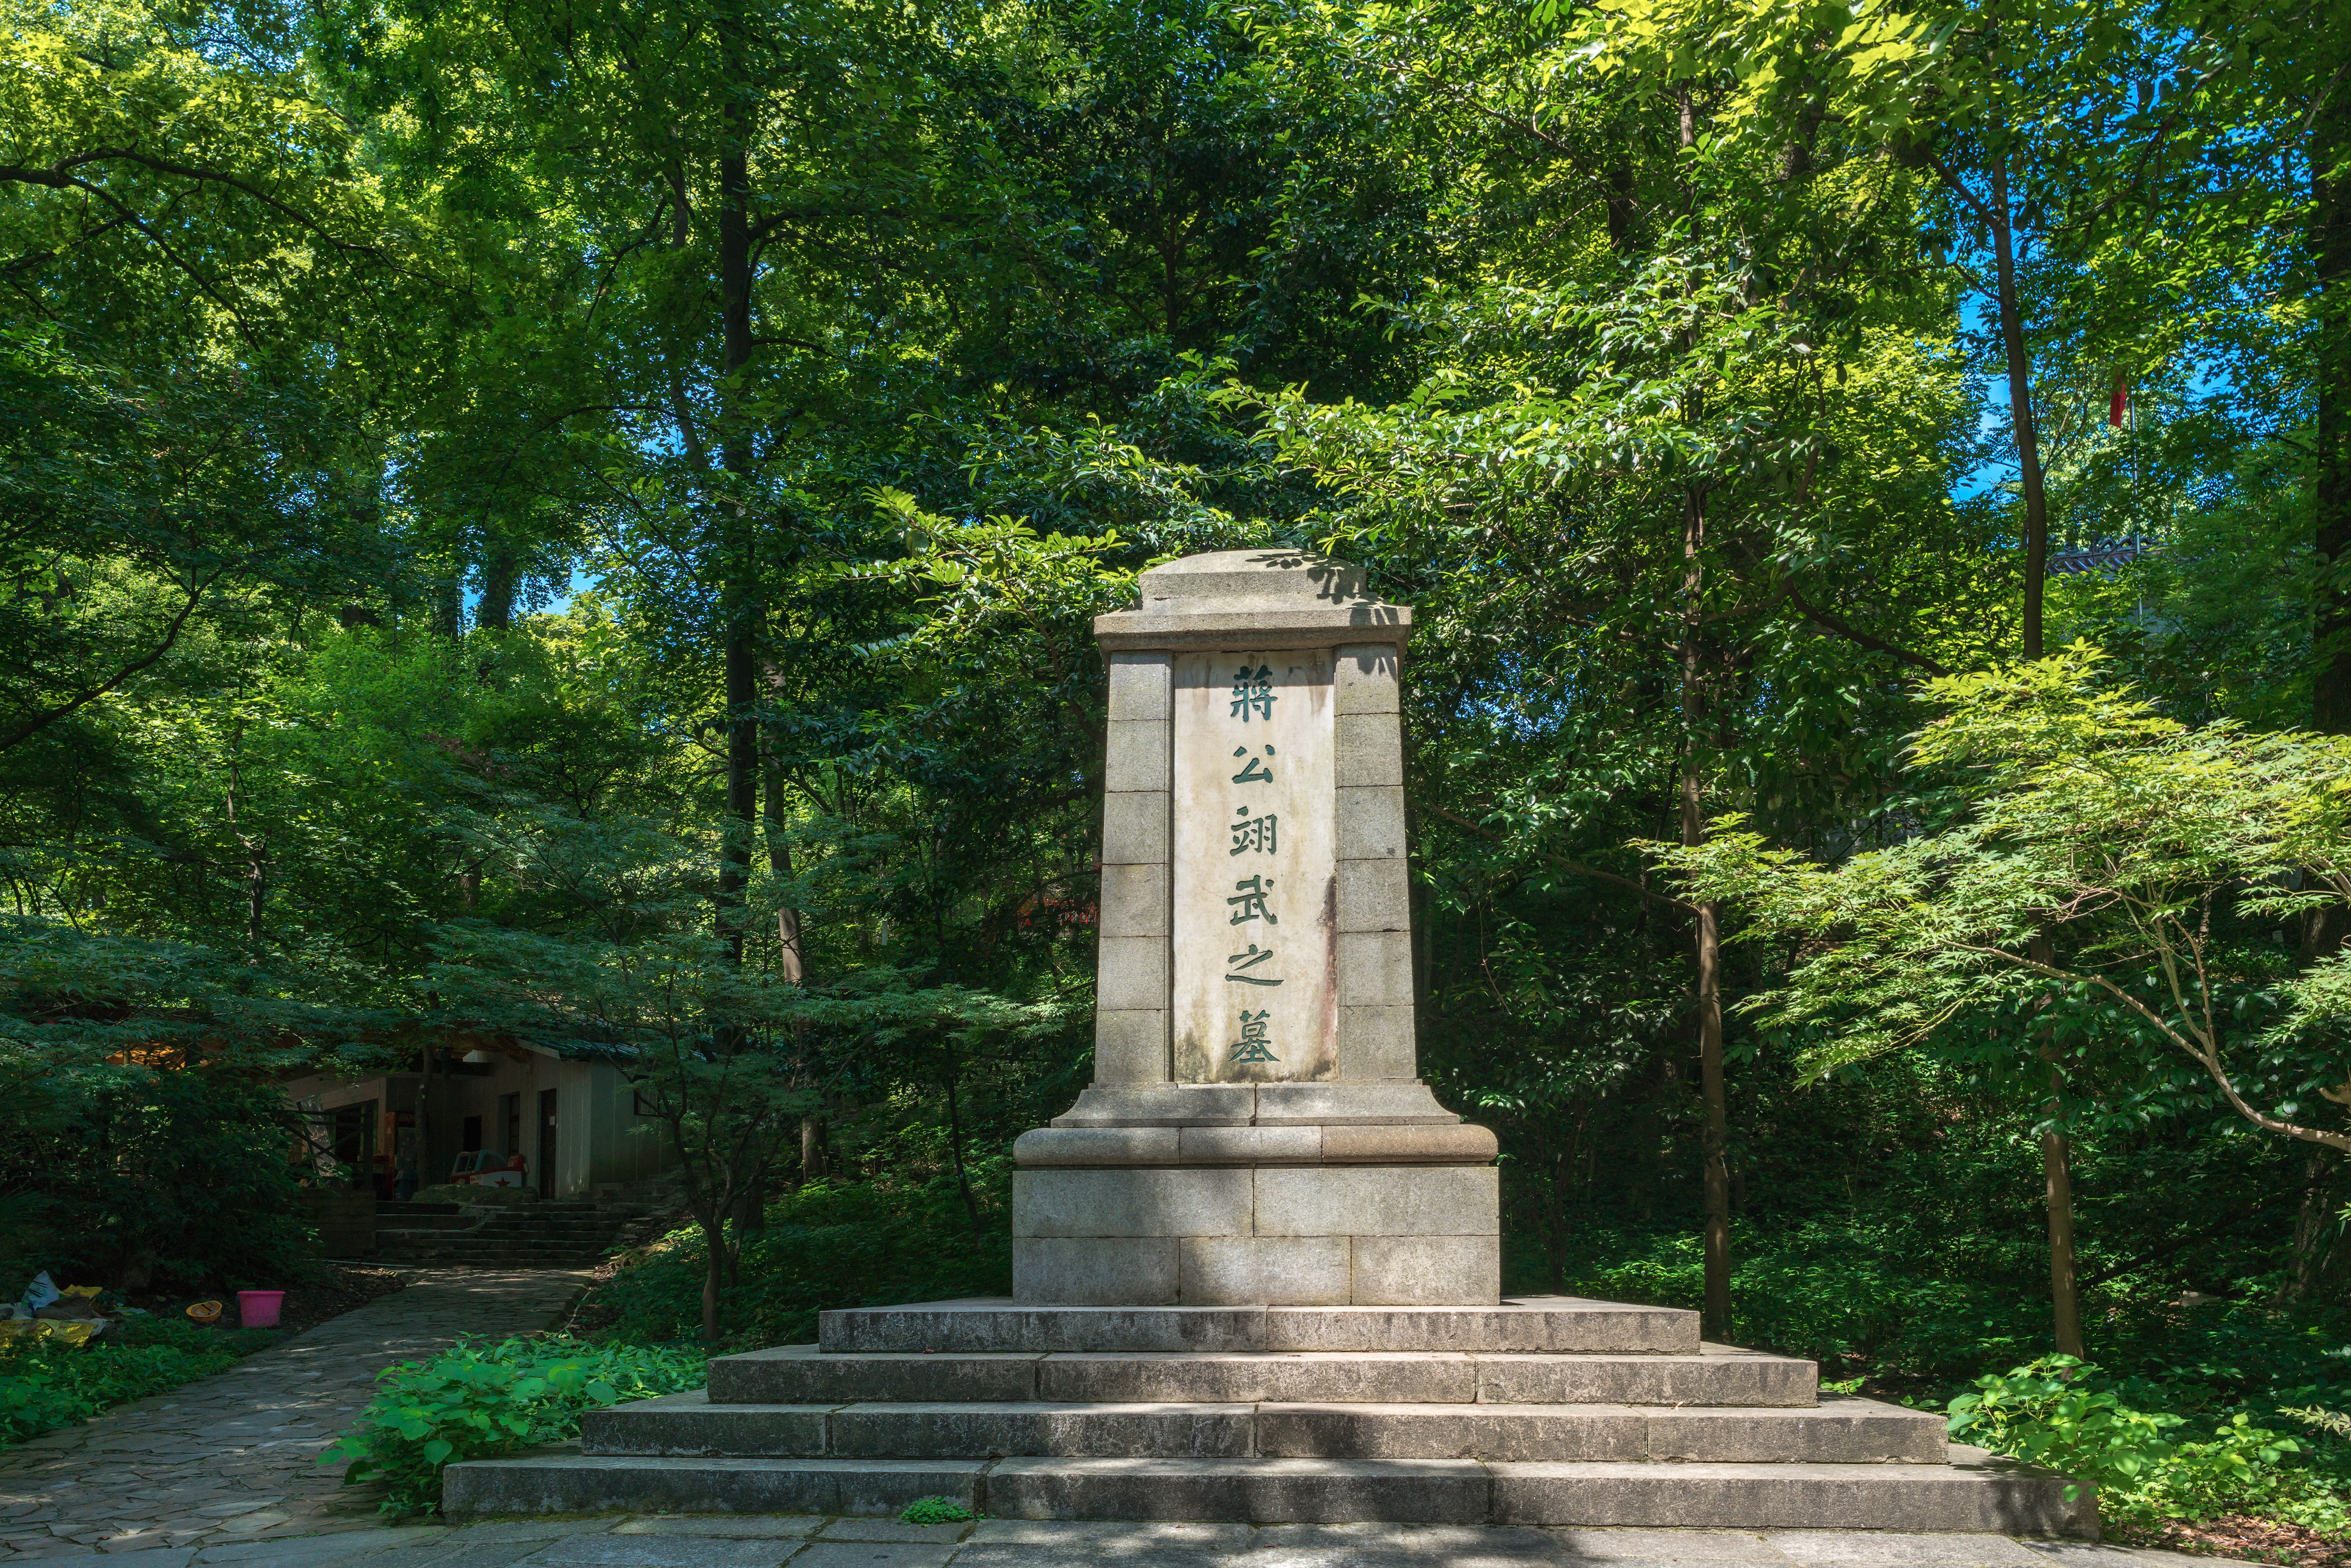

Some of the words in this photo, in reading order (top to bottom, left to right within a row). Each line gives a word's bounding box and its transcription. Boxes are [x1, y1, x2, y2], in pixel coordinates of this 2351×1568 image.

[1225, 664, 1284, 1064] 蔣公翊武之墓
